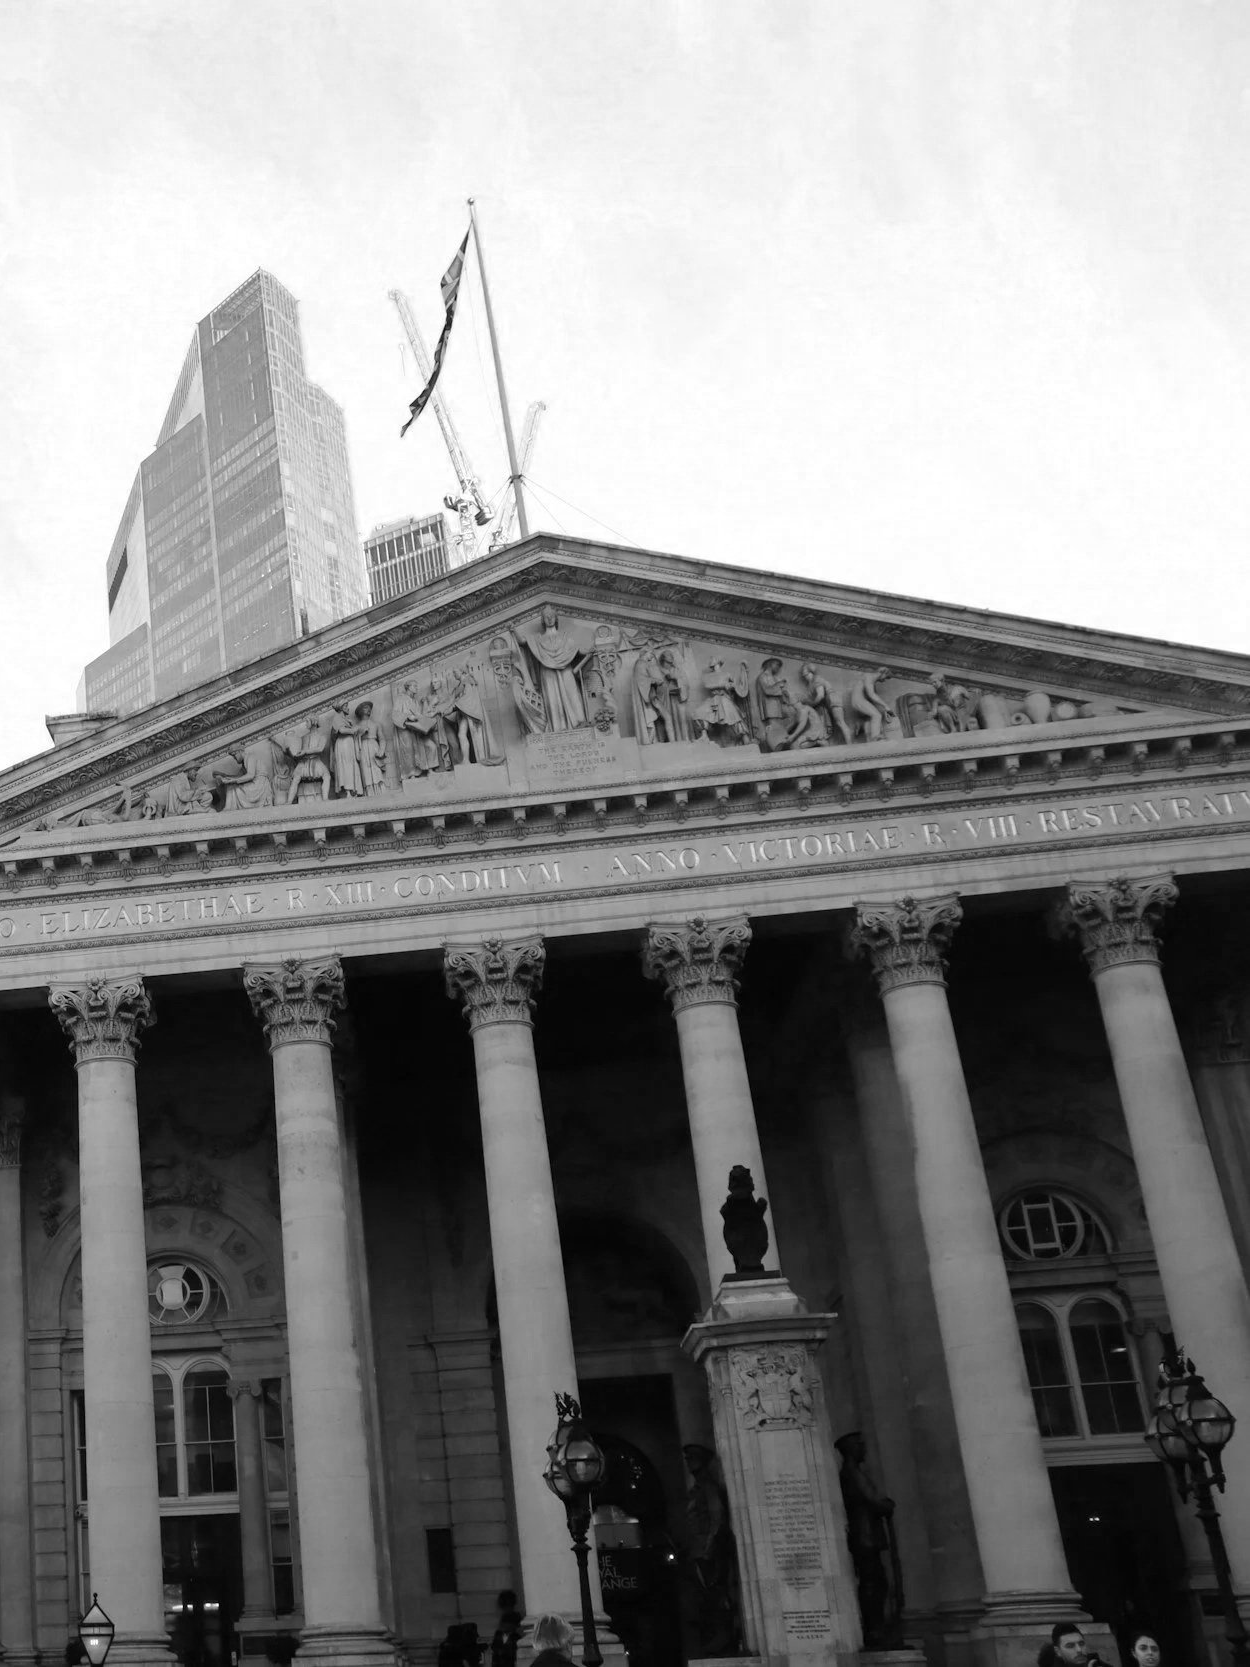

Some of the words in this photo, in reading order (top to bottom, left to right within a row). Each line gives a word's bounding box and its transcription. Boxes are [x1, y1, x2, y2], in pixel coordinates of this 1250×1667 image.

[39, 891, 264, 935] ELIZABETHAE
[285, 888, 307, 911] R
[325, 881, 375, 906] XIII
[393, 861, 564, 899] CONDITVM
[606, 847, 701, 878] ANNO
[722, 825, 902, 865] VICTORIAE
[921, 822, 946, 847] R
[963, 814, 1019, 840] VIII
